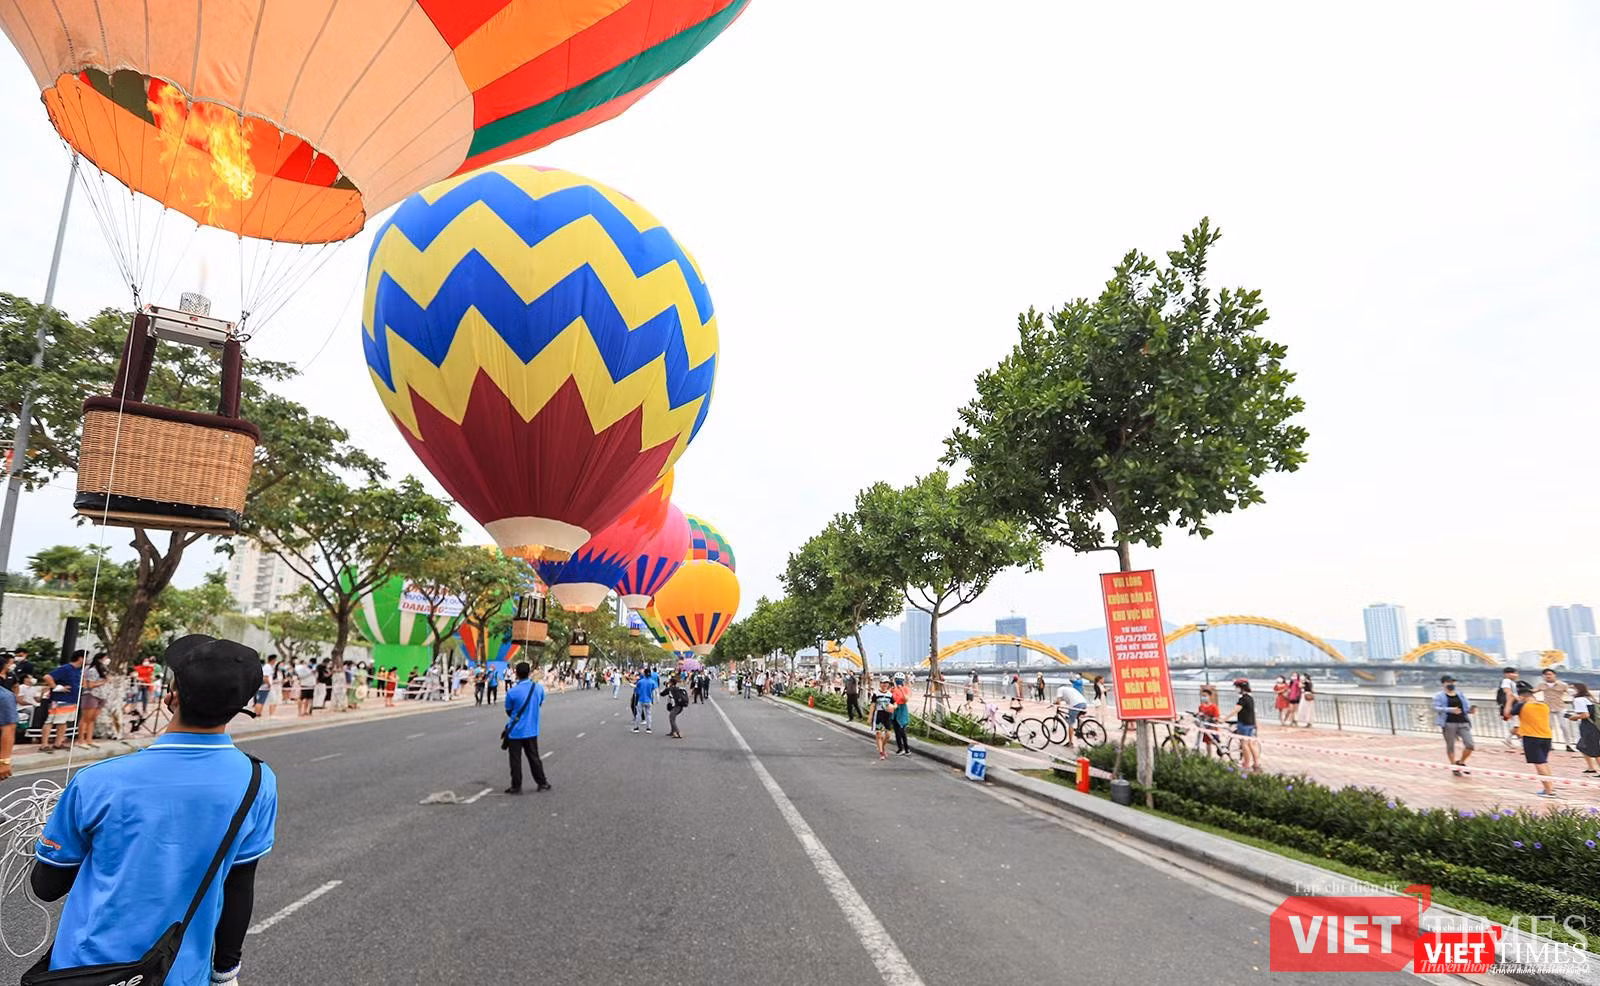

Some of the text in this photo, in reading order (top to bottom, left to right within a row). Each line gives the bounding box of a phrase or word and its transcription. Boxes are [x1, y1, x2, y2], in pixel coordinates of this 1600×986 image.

[1112, 577, 1125, 588] VUI
[1107, 591, 1130, 605] KHÔNG
[1144, 591, 1153, 603] XE
[1112, 607, 1155, 622] KHU VỰC NÀY
[1116, 650, 1160, 660] 27/3/2022
[1131, 667, 1150, 679] PHỤC
[1124, 680, 1145, 694] NGÀY
